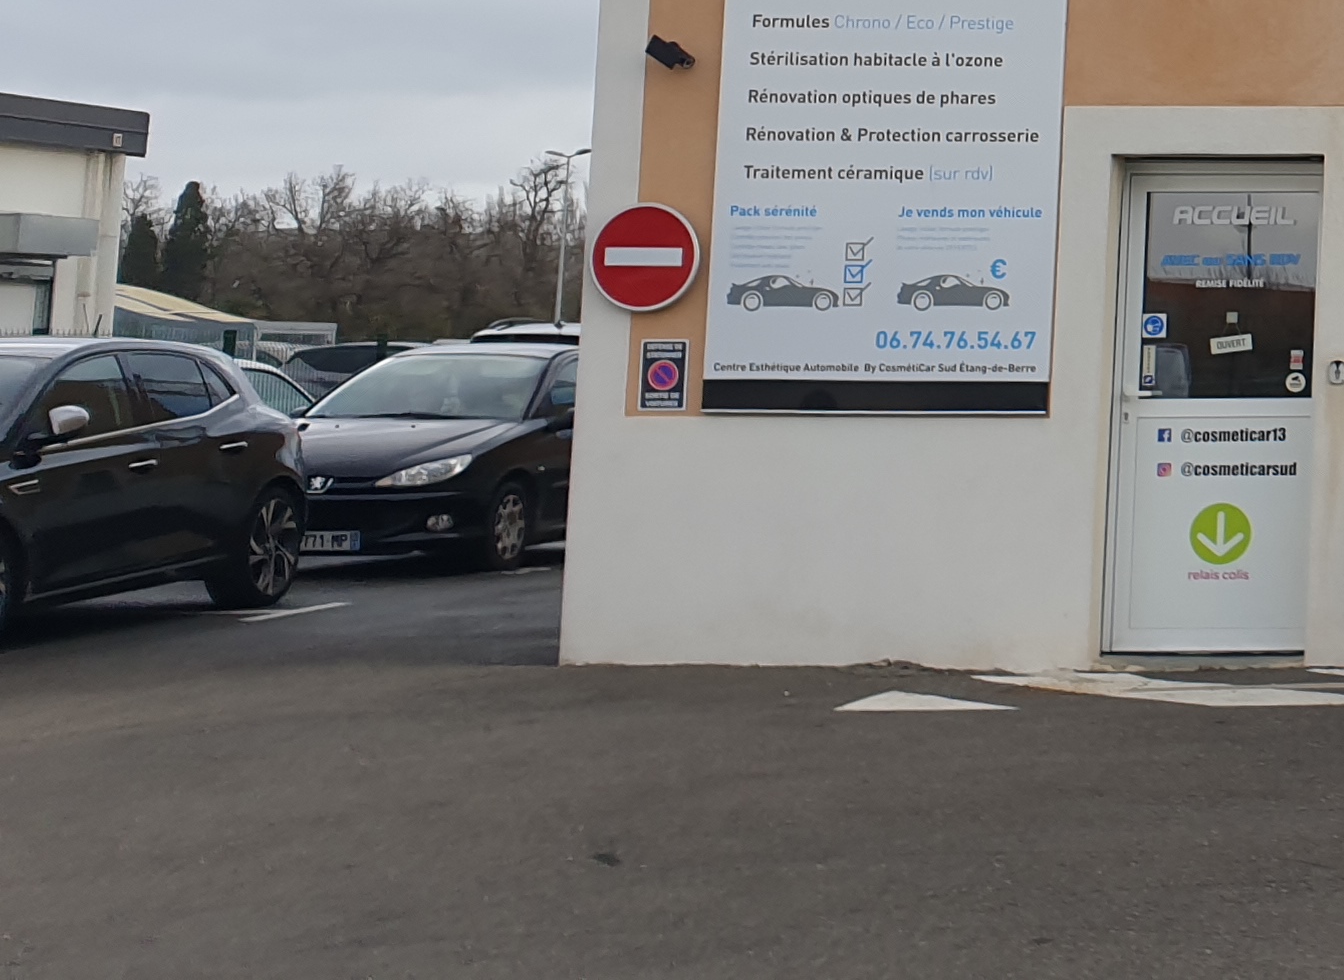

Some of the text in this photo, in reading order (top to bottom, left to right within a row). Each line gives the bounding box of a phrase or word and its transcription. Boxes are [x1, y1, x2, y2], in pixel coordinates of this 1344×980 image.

[752, 15, 830, 29] Formules
[834, 15, 891, 30] Chrono
[907, 16, 934, 30] Eco
[950, 15, 1014, 34] Prestige
[750, 51, 1004, 68] Stérilisation habitacle à l'ozone
[748, 89, 996, 107] Rénovation optiques de phares
[746, 127, 1040, 143] Rénovation & Protection carrosserie
[744, 165, 833, 180] Traitement
[838, 165, 924, 183] céramique
[730, 205, 817, 217] Pack sérénité
[898, 206, 1043, 218] Je vends mon véhicule
[1173, 205, 1296, 226] ACCUEIL
[1226, 254, 1266, 266] SANS
[1196, 280, 1227, 288] REMISE
[875, 330, 1037, 350] 06.74.76.54.67
[1216, 338, 1246, 350] OUVERT
[713, 362, 746, 372] Centre
[749, 362, 801, 374] Esthétique
[803, 363, 860, 372] Automobile
[864, 364, 877, 374] By
[938, 364, 957, 373] Sud
[959, 361, 1037, 374] Étang-de-Berre
[1181, 427, 1286, 443] @cosmeticar13
[1181, 462, 1297, 476] @cosmeticarsud
[1188, 569, 1250, 580] relais colis
